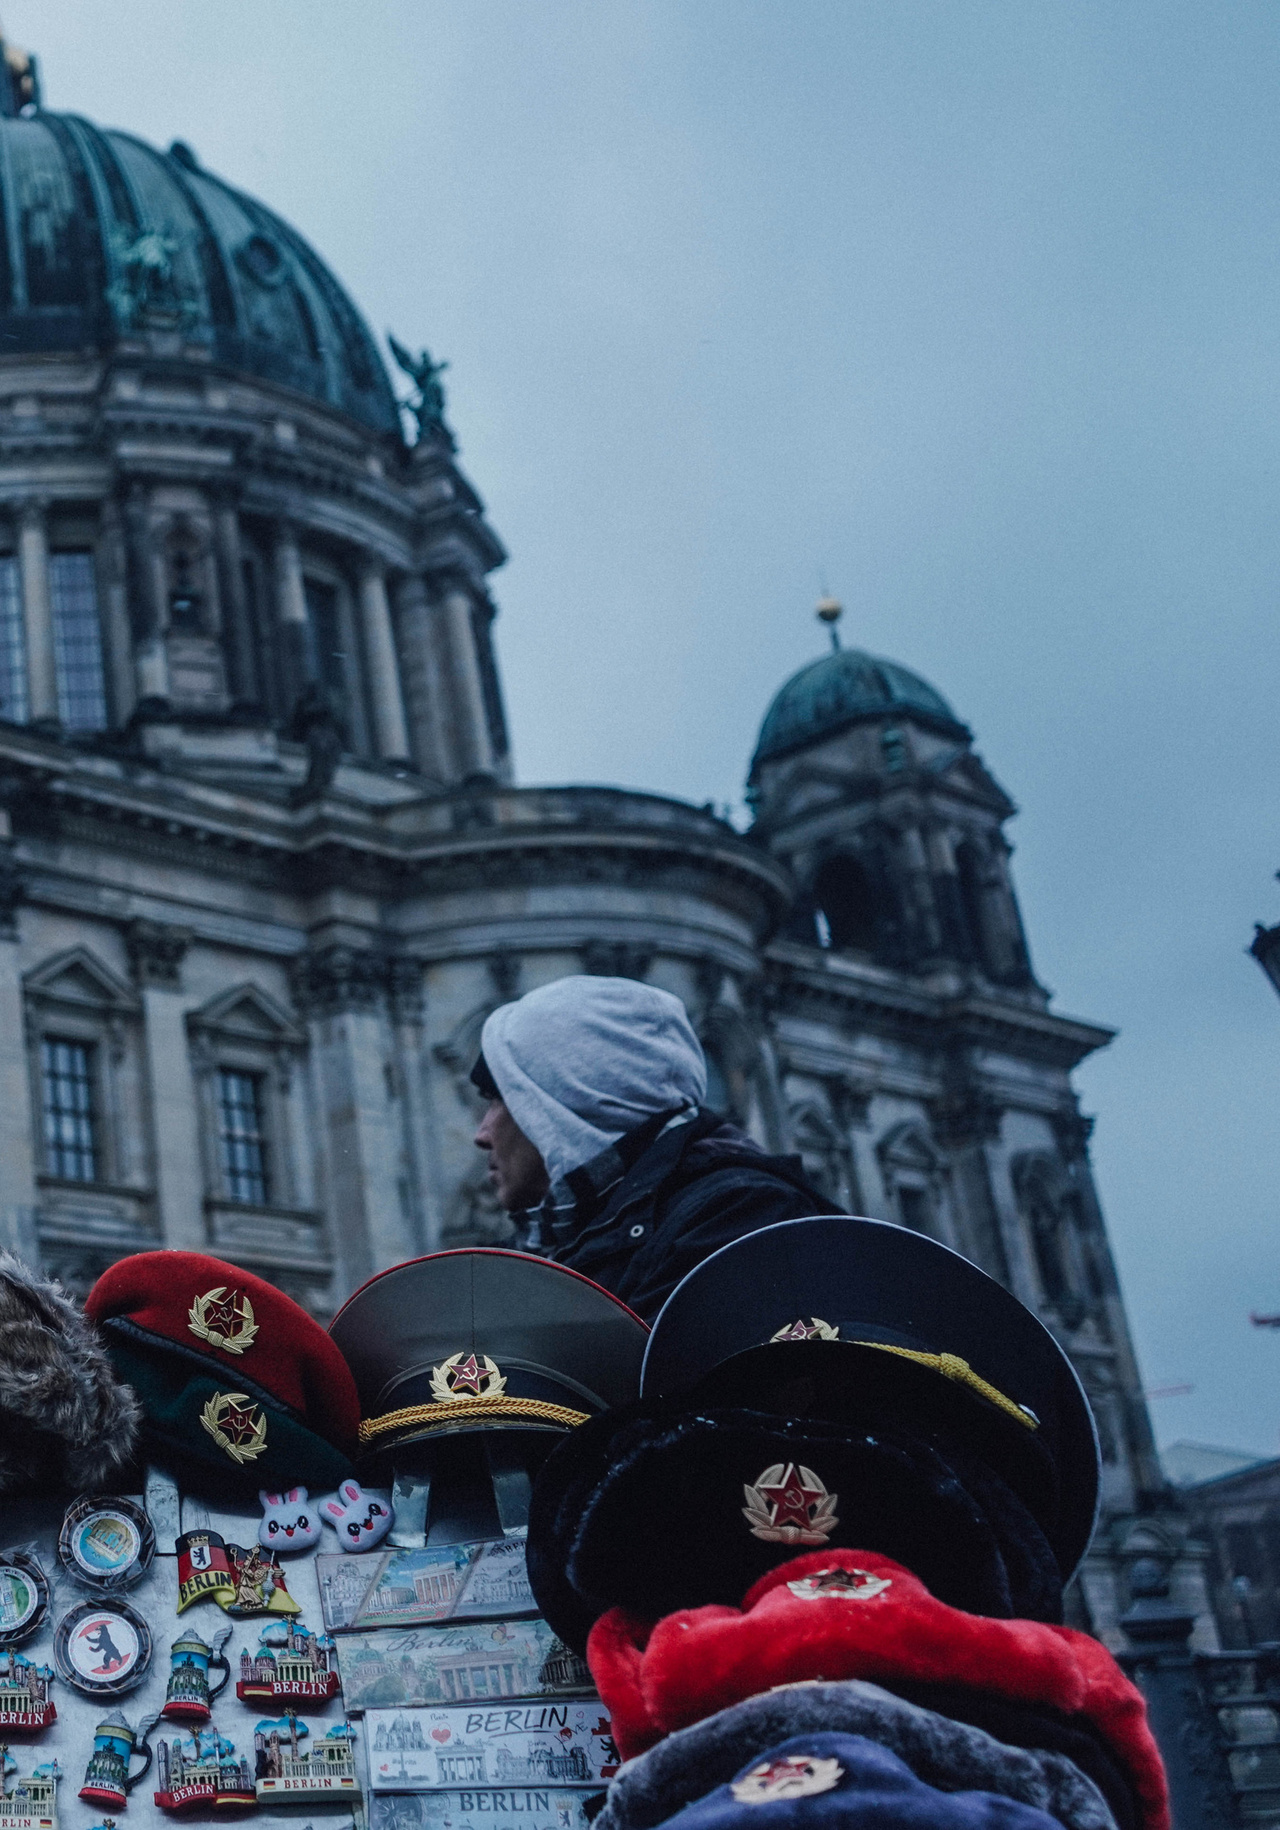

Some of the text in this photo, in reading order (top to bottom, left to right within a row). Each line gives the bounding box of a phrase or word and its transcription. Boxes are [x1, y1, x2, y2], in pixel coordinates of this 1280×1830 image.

[179, 1571, 232, 1604] BERLIN
[386, 1629, 471, 1652] Berlin
[273, 1682, 328, 1695] BERLIN
[466, 1706, 568, 1734] BERLIN
[90, 1781, 115, 1790] BERLIN
[283, 1778, 333, 1789] BERLIN
[173, 1784, 215, 1803] BERLIN
[459, 1792, 551, 1812] BERLIN
